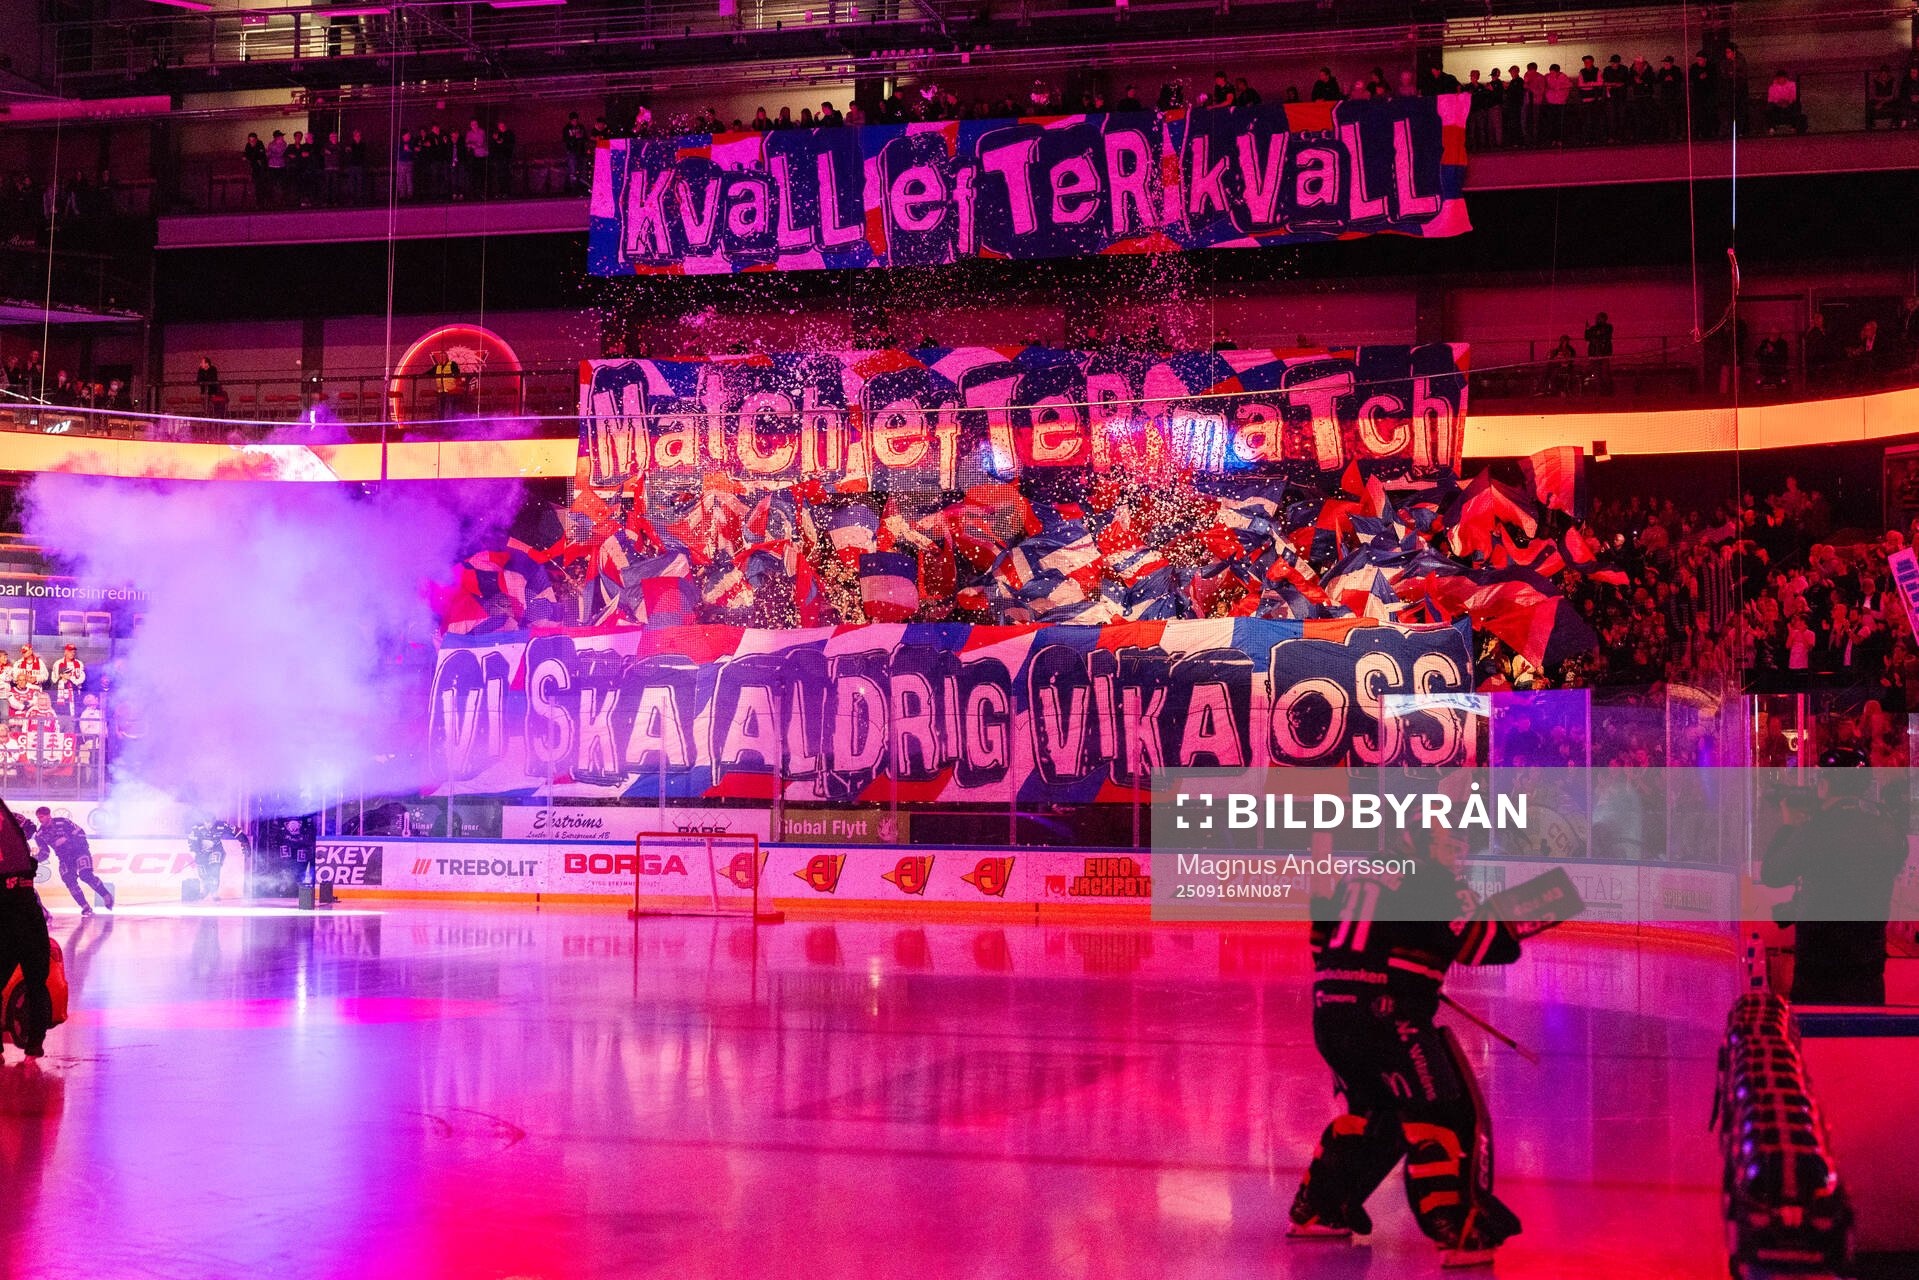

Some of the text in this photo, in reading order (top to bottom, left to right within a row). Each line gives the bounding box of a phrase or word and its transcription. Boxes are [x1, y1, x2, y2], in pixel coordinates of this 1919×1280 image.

[26, 582, 157, 602] kontorsinrednin
[441, 677, 503, 761] VI
[530, 658, 688, 774] SKA
[720, 669, 1009, 773] ALDRIG
[1039, 675, 1246, 776] VIKA
[832, 820, 868, 838] Flytt
[315, 846, 376, 865] CKEY
[565, 853, 688, 876] BORGA
[315, 866, 367, 885] ORE
[436, 858, 538, 877] TREBOLIT
[1084, 857, 1133, 877] EURO
